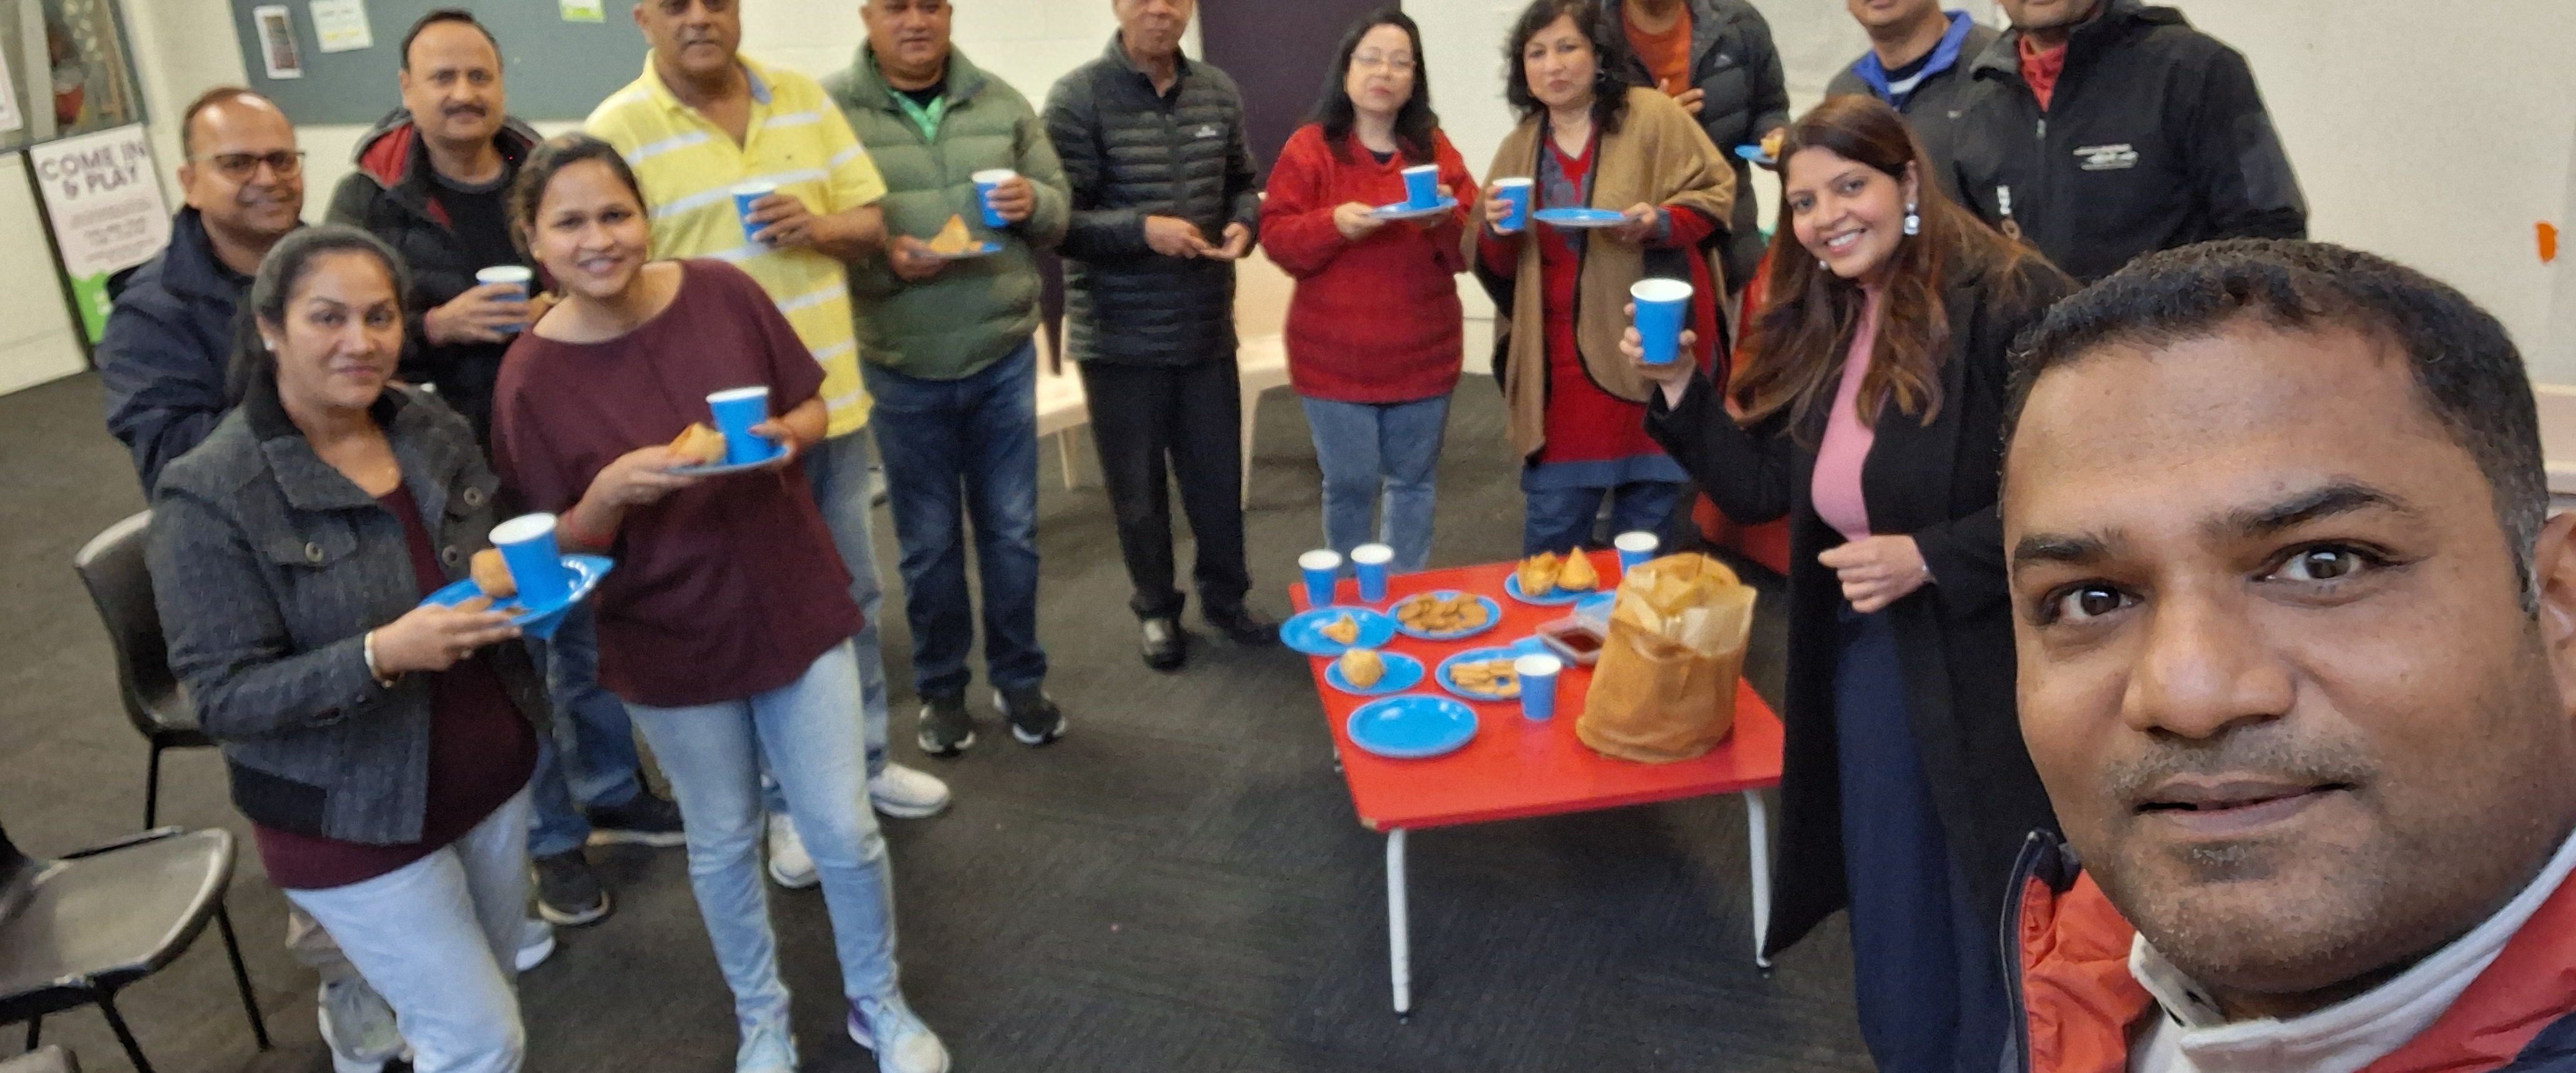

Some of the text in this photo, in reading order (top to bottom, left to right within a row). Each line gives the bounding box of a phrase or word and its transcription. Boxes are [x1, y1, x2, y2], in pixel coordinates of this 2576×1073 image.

[39, 140, 146, 182] COME IN
[85, 164, 139, 193] PLAY
